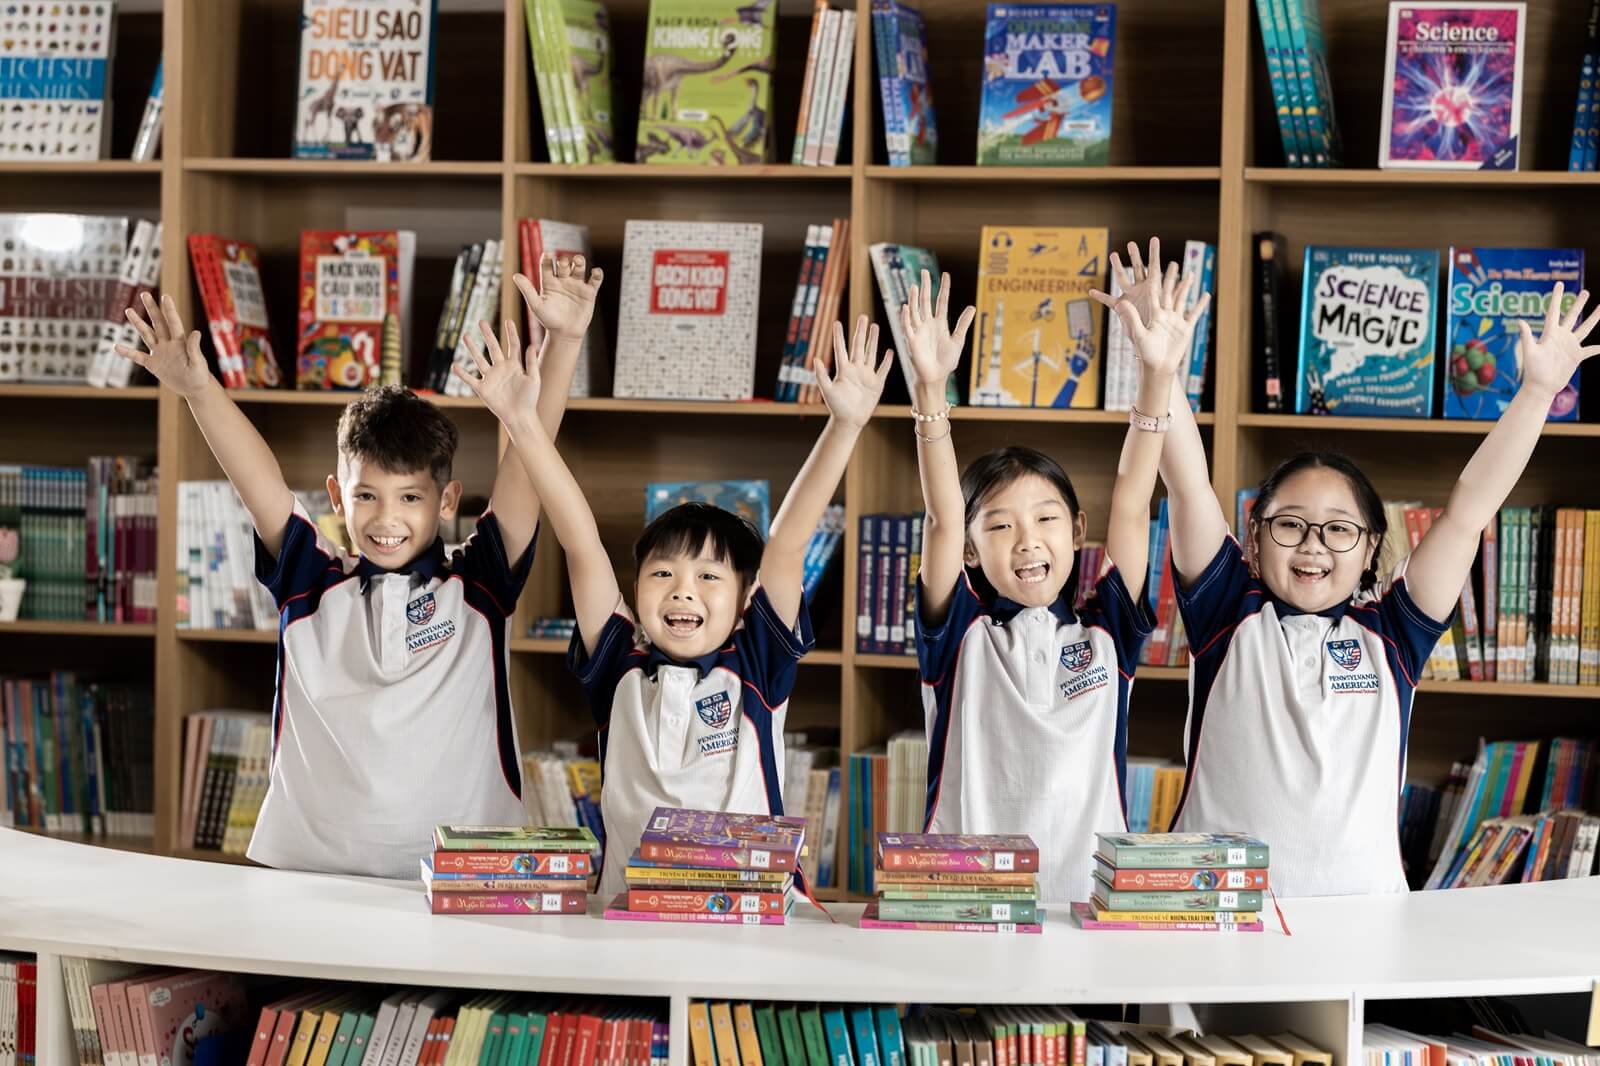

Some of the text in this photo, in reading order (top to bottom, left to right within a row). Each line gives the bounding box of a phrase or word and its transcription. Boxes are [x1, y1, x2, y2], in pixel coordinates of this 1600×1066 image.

[376, 9, 422, 40] SAO
[1416, 21, 1499, 41] Science
[1005, 33, 1091, 50] MAKER
[1003, 50, 1092, 79] LAB
[1348, 253, 1376, 263] STEVE
[987, 278, 1095, 293] ENGINEERING
[1320, 274, 1425, 314] SCIENCE
[1318, 304, 1420, 348] MAGIC
[405, 619, 453, 643] PENNSYLVANIA
[408, 624, 456, 651] AMERICAN
[1060, 665, 1106, 690] PENNSYLVANIA
[1063, 672, 1109, 698] AMERICAN
[1328, 673, 1379, 682] PENNSYLVANIA
[1331, 681, 1379, 690] AMERICAN
